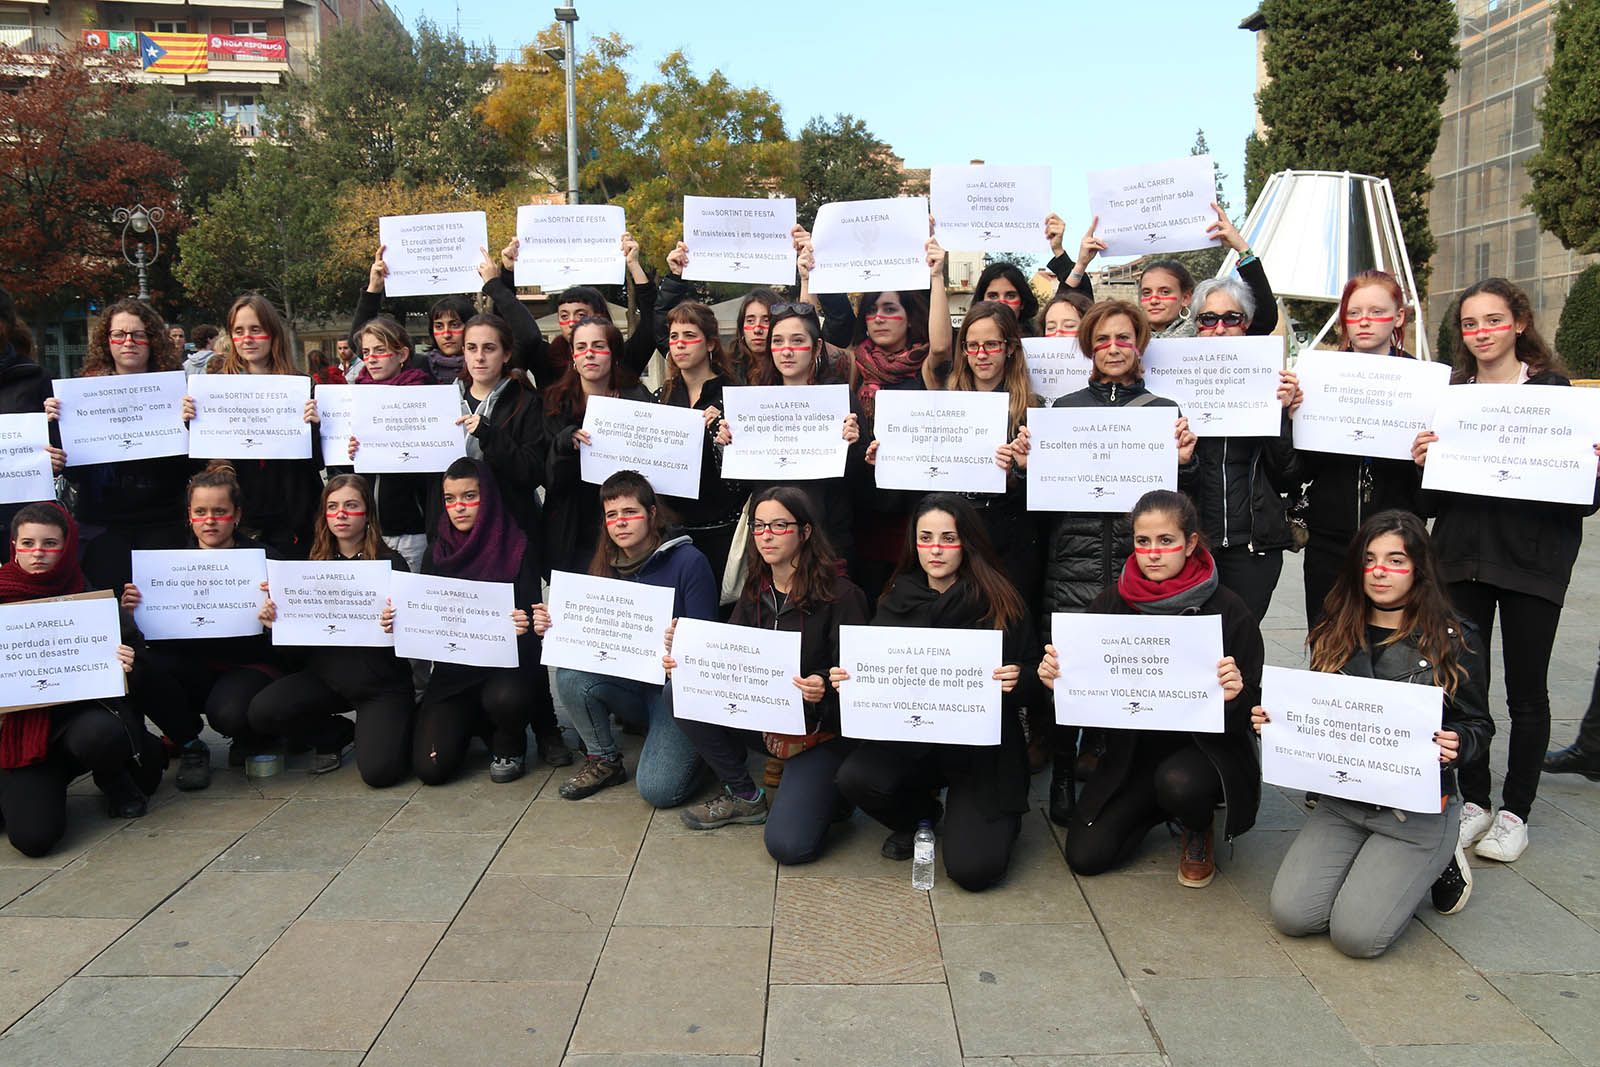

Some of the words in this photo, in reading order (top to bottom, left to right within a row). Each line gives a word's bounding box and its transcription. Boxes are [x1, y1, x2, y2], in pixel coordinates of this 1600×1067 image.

[967, 196, 992, 204] Opines
[1109, 199, 1124, 208] Tinc
[1126, 198, 1138, 207] por
[1146, 192, 1175, 203] caminar
[1177, 190, 1194, 199] sola
[1141, 204, 1150, 213] de
[1152, 203, 1162, 211] nit
[753, 231, 787, 240] segueixes
[1150, 367, 1192, 376] Repeteixes
[98, 388, 127, 396] SORTINT
[76, 408, 88, 416] No
[90, 406, 116, 415] entens
[218, 406, 260, 415] discoteques
[276, 406, 297, 415] gratis
[110, 414, 143, 425] resposta
[1382, 419, 1426, 429] MASCLISTA
[1459, 420, 1478, 431] Tinc
[1480, 424, 1497, 434] por
[1508, 423, 1548, 434] caminar
[1551, 425, 1572, 435] sola
[912, 435, 932, 443] jugar
[940, 434, 962, 444] pilota
[10, 446, 34, 456] gratis
[1040, 441, 1077, 449] Escolten
[1121, 441, 1146, 449] home
[1148, 443, 1165, 451] que
[1100, 451, 1111, 459] mi
[0, 470, 41, 478] MASCLISTA
[237, 579, 250, 587] per
[616, 598, 634, 606] FEINA
[408, 601, 419, 609] Em
[421, 603, 432, 611] diu
[434, 605, 448, 614] que
[37, 619, 74, 629] PARELLA
[582, 625, 632, 640] contractar-me
[40, 647, 79, 658] desastre
[1104, 654, 1138, 666] Opines
[1141, 654, 1169, 664] sobre
[711, 671, 730, 681] voler
[732, 674, 742, 682] fer
[744, 675, 768, 686] l'amor
[856, 674, 875, 683] amb
[892, 675, 926, 688] objecte
[929, 677, 940, 686] de
[943, 678, 964, 688] molt
[967, 681, 984, 691] pes
[1158, 690, 1208, 699] MASCLISTA
[1331, 699, 1342, 708] AL
[1345, 701, 1383, 713] CARRER
[1297, 724, 1326, 737] xiules
[1329, 728, 1346, 740] des
[1350, 731, 1366, 743] del
[1369, 734, 1399, 748] cotxe
